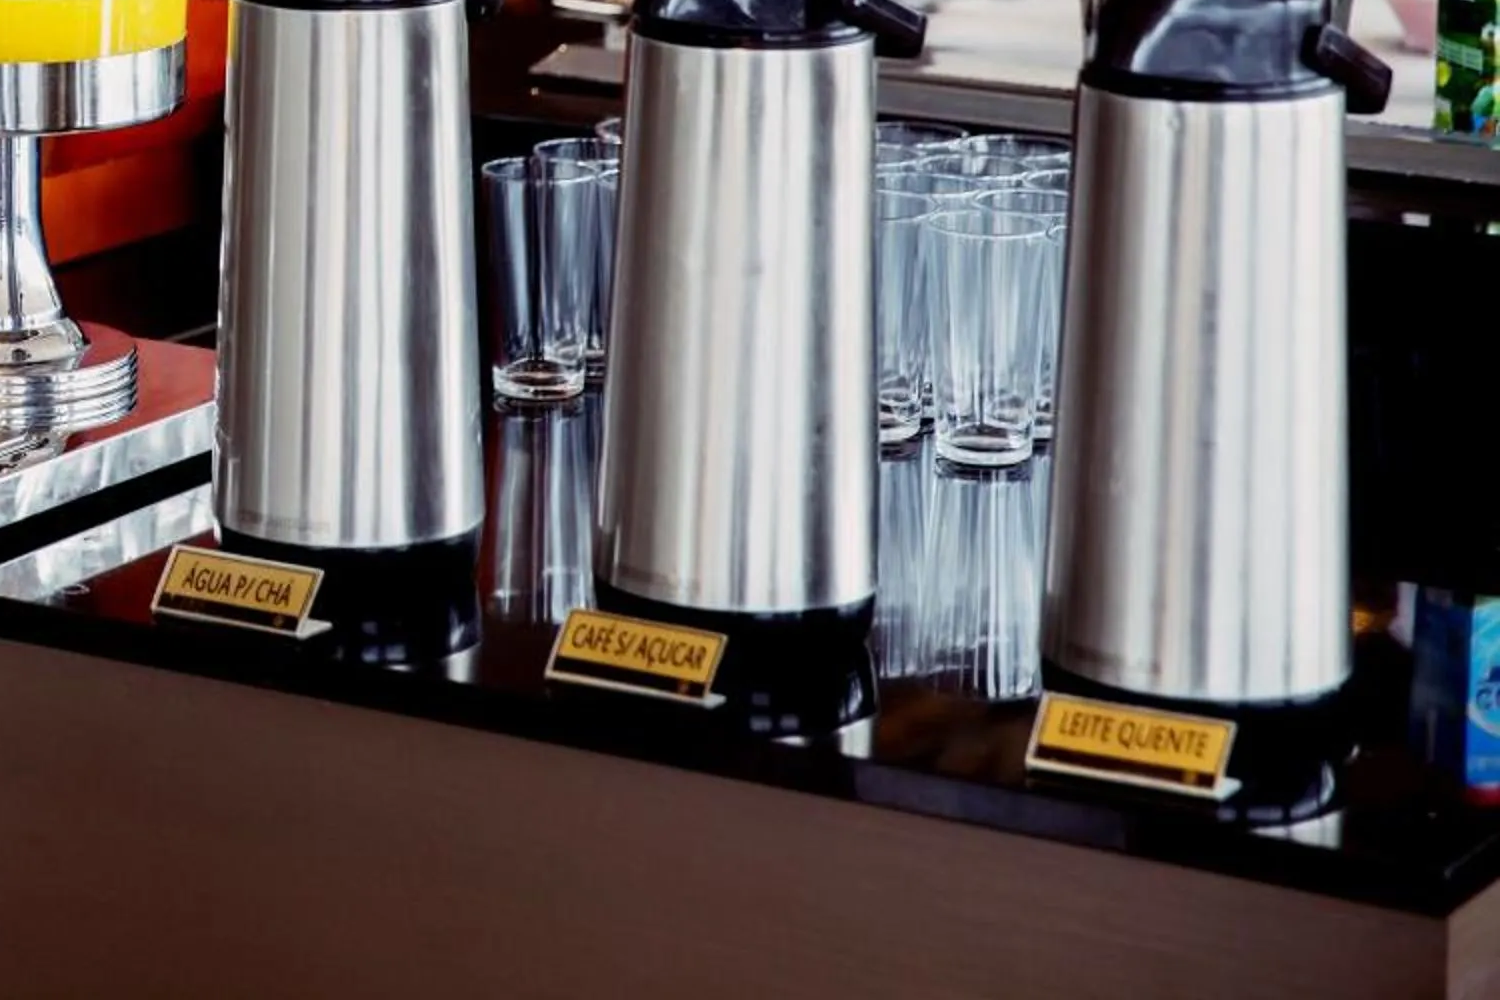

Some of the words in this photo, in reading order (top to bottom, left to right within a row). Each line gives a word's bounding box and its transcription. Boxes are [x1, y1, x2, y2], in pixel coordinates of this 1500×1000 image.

[182, 560, 231, 597] ÁGUA
[232, 573, 255, 599] P/
[255, 577, 296, 607] CHÁ
[571, 622, 616, 653] CAFÉ
[614, 630, 636, 658] S/
[1058, 709, 1115, 743] LEITE
[1117, 719, 1210, 759] QUENTE
